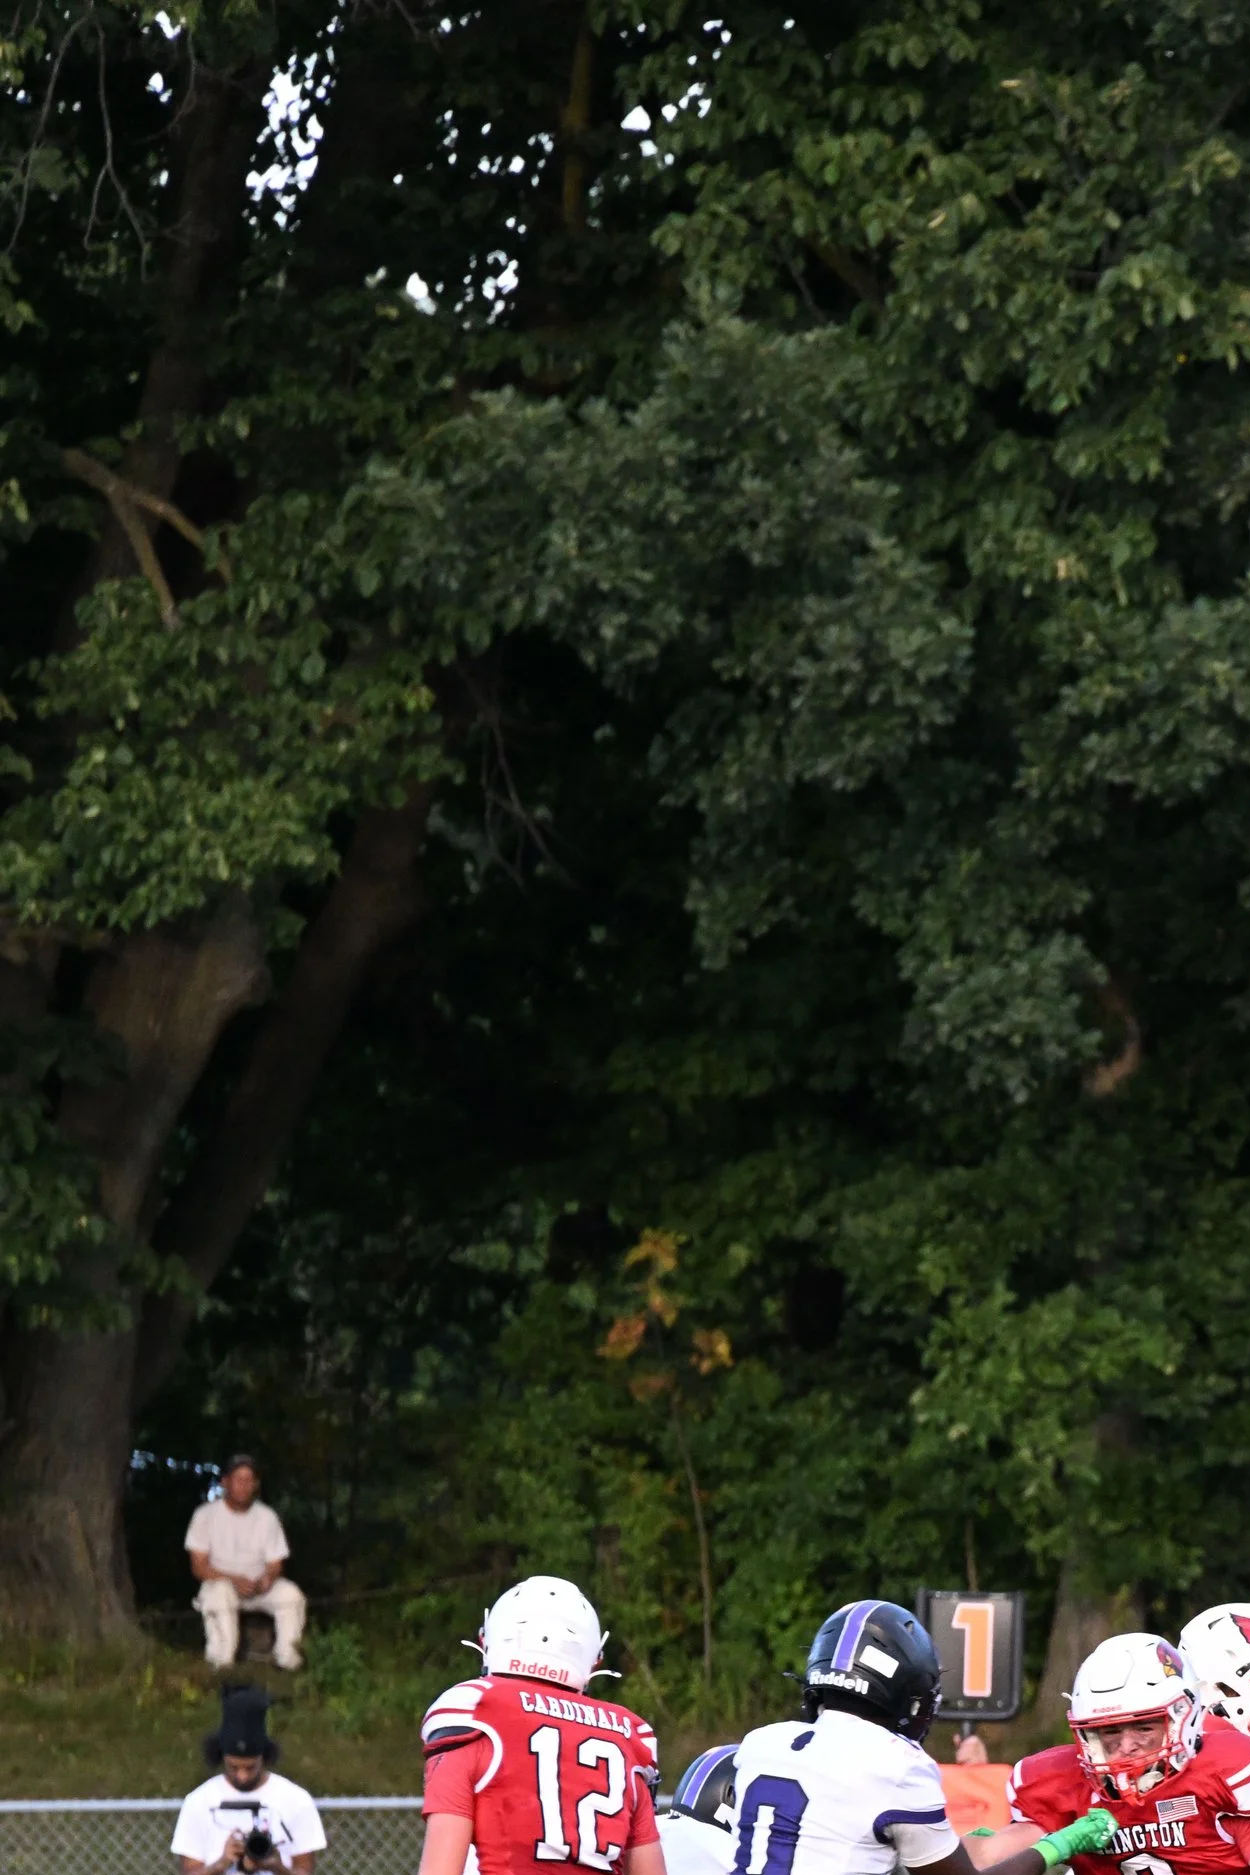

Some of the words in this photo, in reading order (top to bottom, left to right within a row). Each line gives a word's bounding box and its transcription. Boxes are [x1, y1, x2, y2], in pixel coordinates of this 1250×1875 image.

[952, 1602, 995, 1698] 1
[509, 1659, 569, 1683] Riddell
[809, 1671, 869, 1695] Riddell
[519, 1691, 632, 1739] CARDINALS
[529, 1725, 627, 1873] 12
[1098, 1821, 1187, 1855] INGTON
